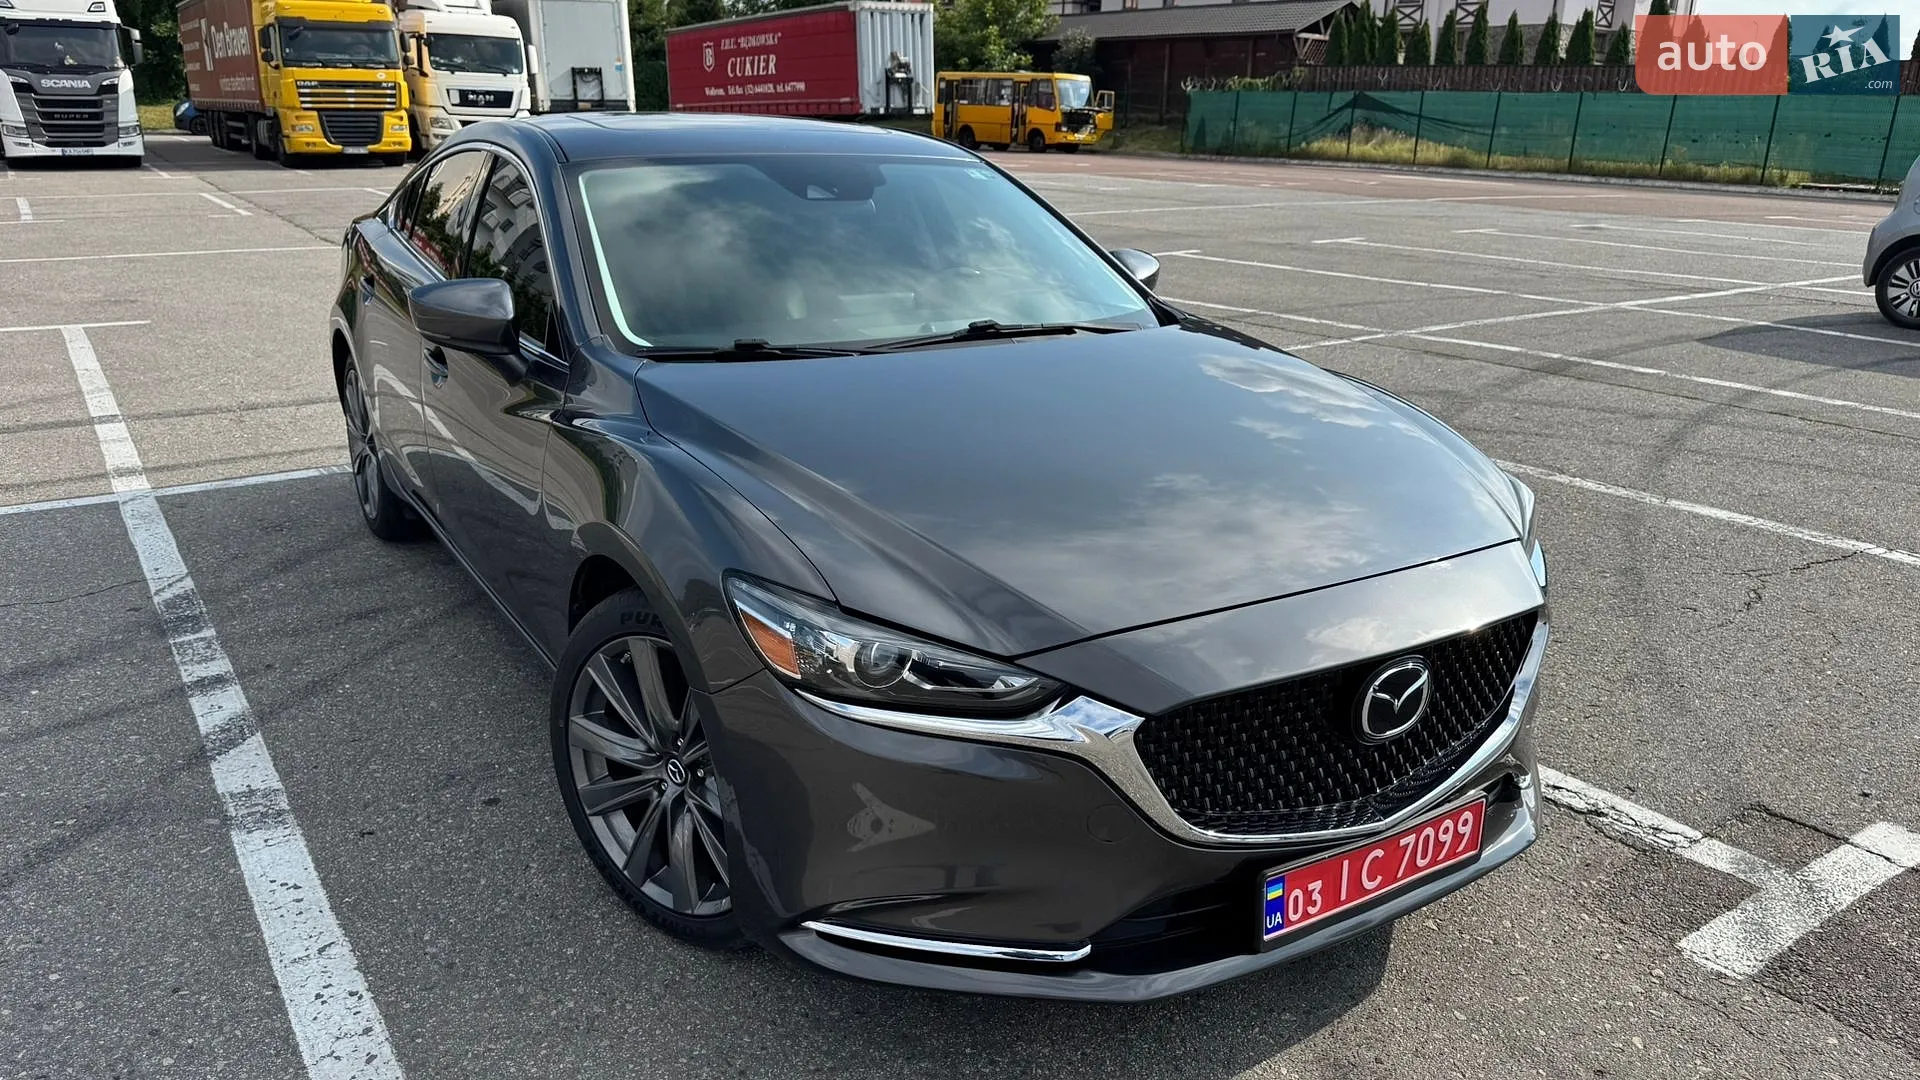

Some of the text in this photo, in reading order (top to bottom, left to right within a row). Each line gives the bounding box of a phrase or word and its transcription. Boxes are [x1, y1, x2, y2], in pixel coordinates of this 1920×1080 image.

[727, 54, 777, 77] CUKIER
[40, 79, 91, 88] SCANIA
[467, 94, 494, 102] MAN
[1288, 879, 1322, 922] 03
[1397, 811, 1473, 878] 7099
[1267, 912, 1282, 928] UA
